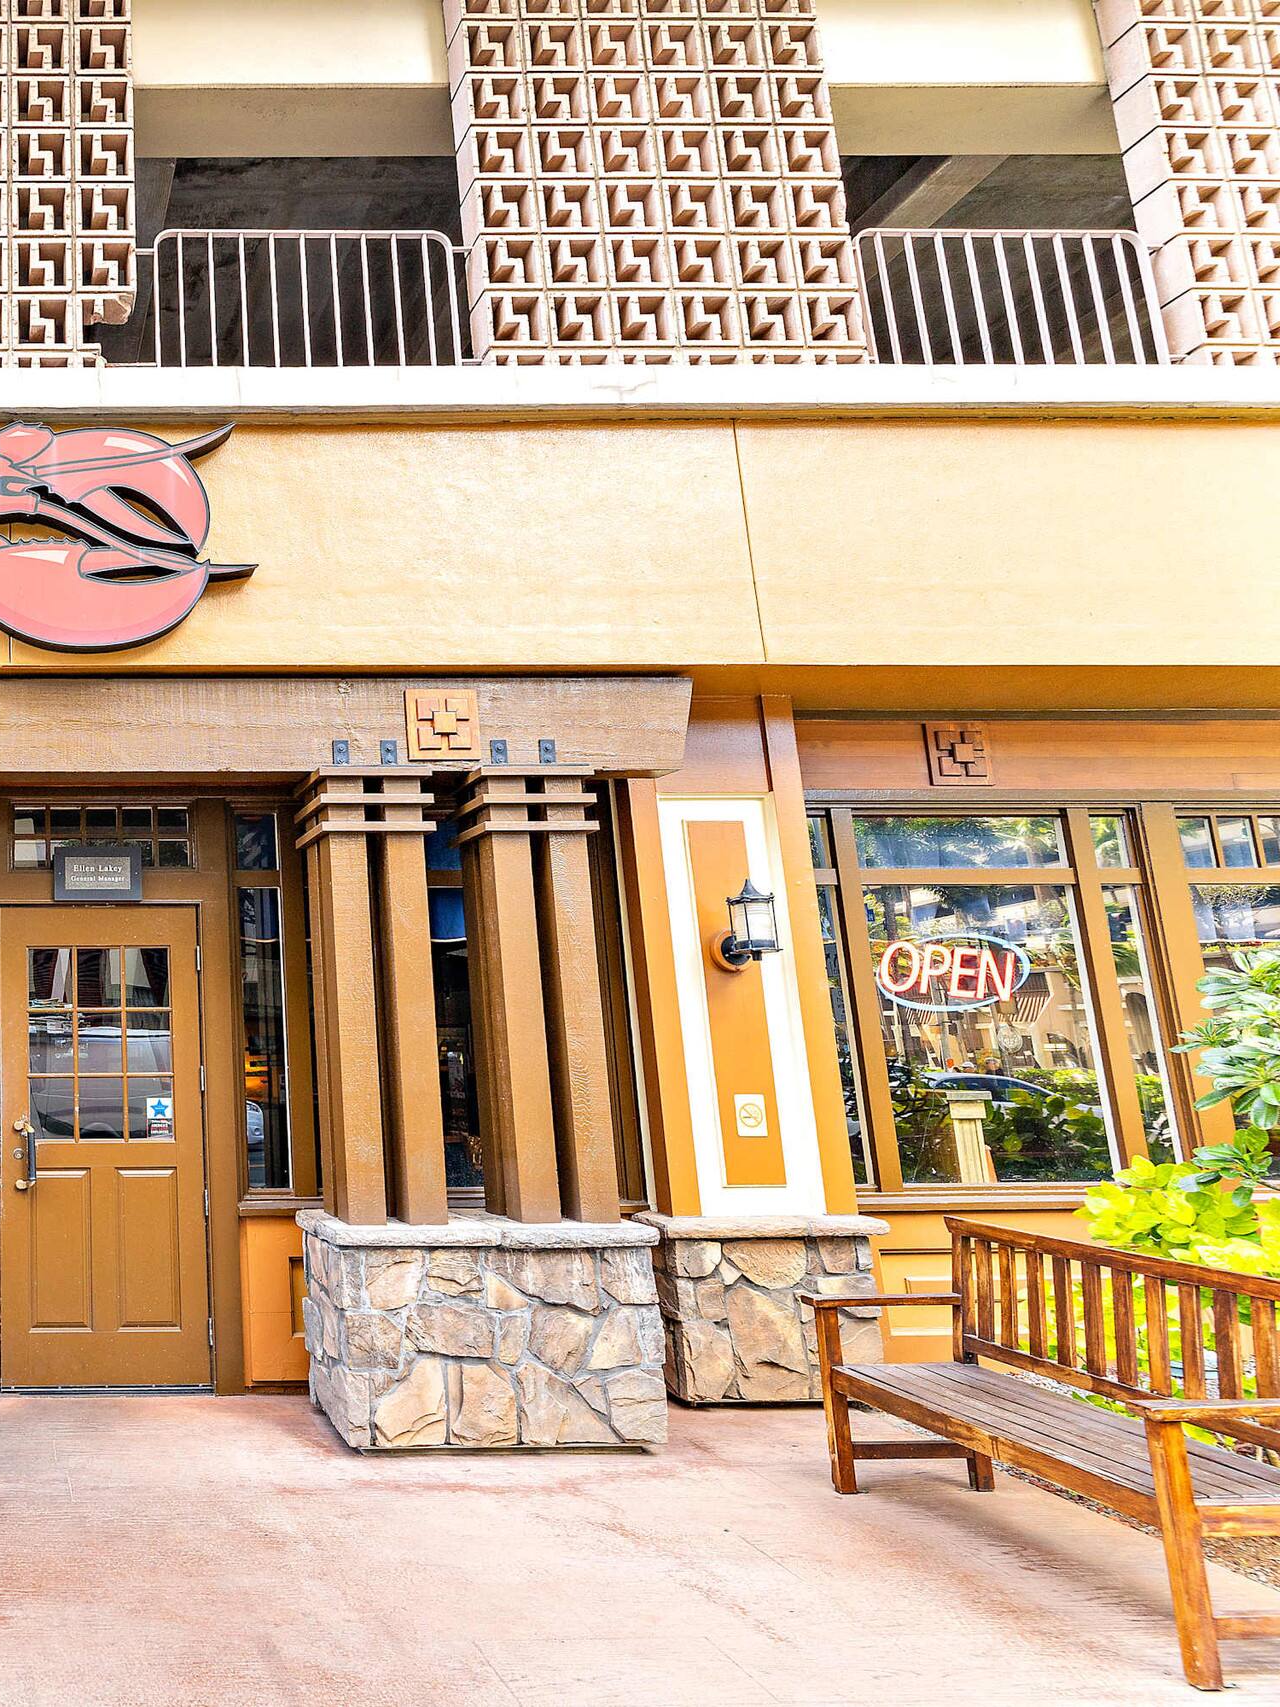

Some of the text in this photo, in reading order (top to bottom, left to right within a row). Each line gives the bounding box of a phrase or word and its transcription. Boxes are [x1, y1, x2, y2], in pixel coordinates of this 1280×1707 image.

[73, 864, 95, 872] Ellen
[97, 875, 125, 883] Manager
[880, 941, 1016, 1002] OPEN
